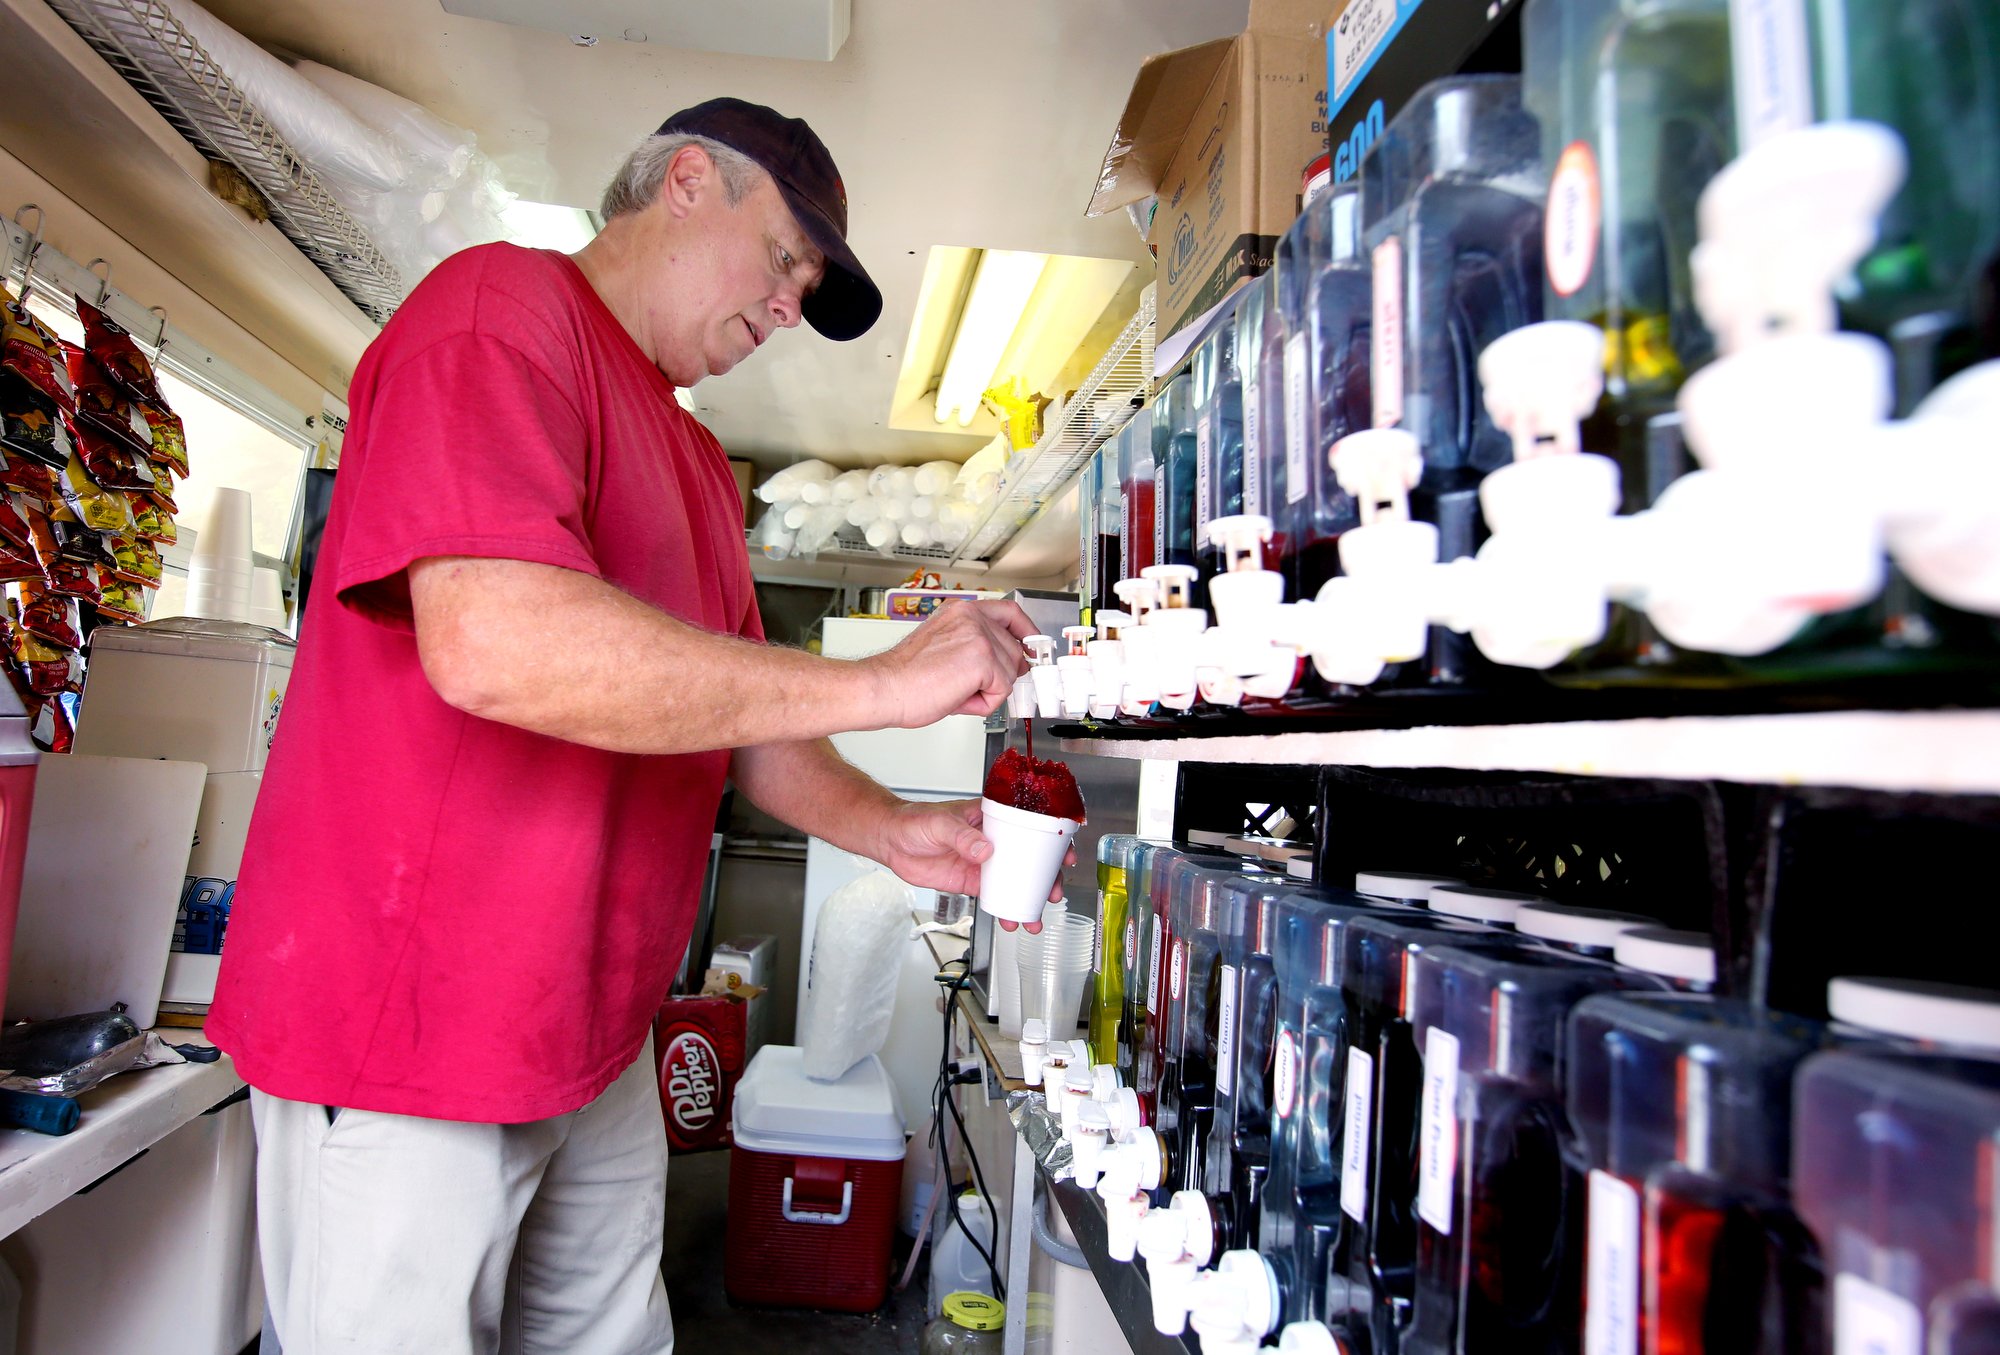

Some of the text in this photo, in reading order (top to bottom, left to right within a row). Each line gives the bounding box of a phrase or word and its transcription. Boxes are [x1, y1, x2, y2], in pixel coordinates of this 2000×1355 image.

[1179, 223, 1194, 267] Max
[1226, 249, 1245, 281] Max
[1248, 407, 1256, 506] Cotton Candy
[668, 1063, 693, 1098] Dr
[674, 1038, 715, 1130] Pepper
[1350, 1094, 1362, 1171] Tamarind
